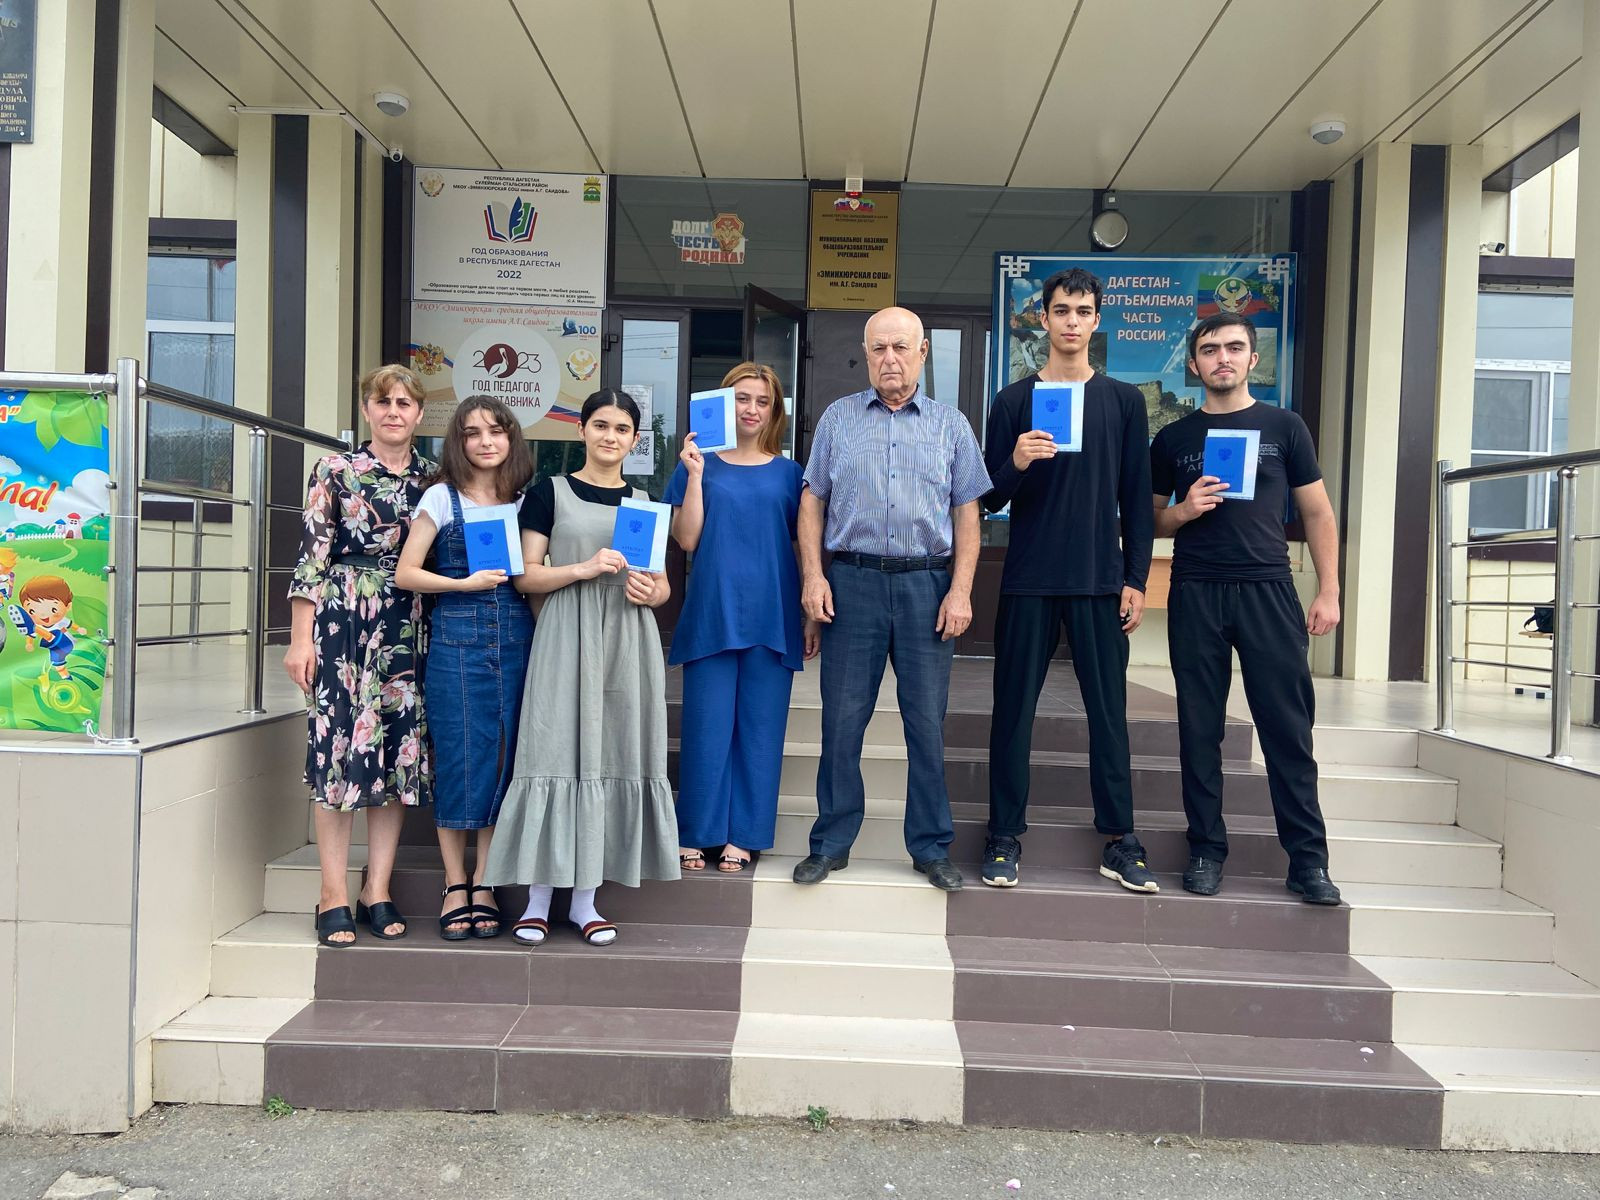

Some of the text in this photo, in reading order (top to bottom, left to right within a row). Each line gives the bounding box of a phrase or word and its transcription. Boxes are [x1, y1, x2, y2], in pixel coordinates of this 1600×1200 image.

[0, 87, 23, 95] ДУЛА
[0, 95, 27, 103] ОВИЧА
[671, 220, 709, 235] ДОЛГ
[675, 235, 720, 249] ЧЕСТЬ
[471, 247, 549, 257] ГОД ОБРАЗОВАНИЯ
[682, 249, 744, 264] РОДИНА!
[466, 257, 518, 266] РЕСПУБЛИКЕ
[519, 260, 561, 268] ДАГЕСТАН
[497, 270, 522, 279] 2022
[1107, 276, 1170, 289] ДАГЕСТАН
[1100, 294, 1194, 307] ЕОТЪЕМЛЕМАЯ
[1122, 312, 1162, 324] ЧАСТЬ
[579, 325, 597, 335] 100
[1117, 330, 1166, 341] РОССИИ
[472, 379, 541, 393] ГОД ПЕДАГОГА
[0, 478, 57, 512] ла!
